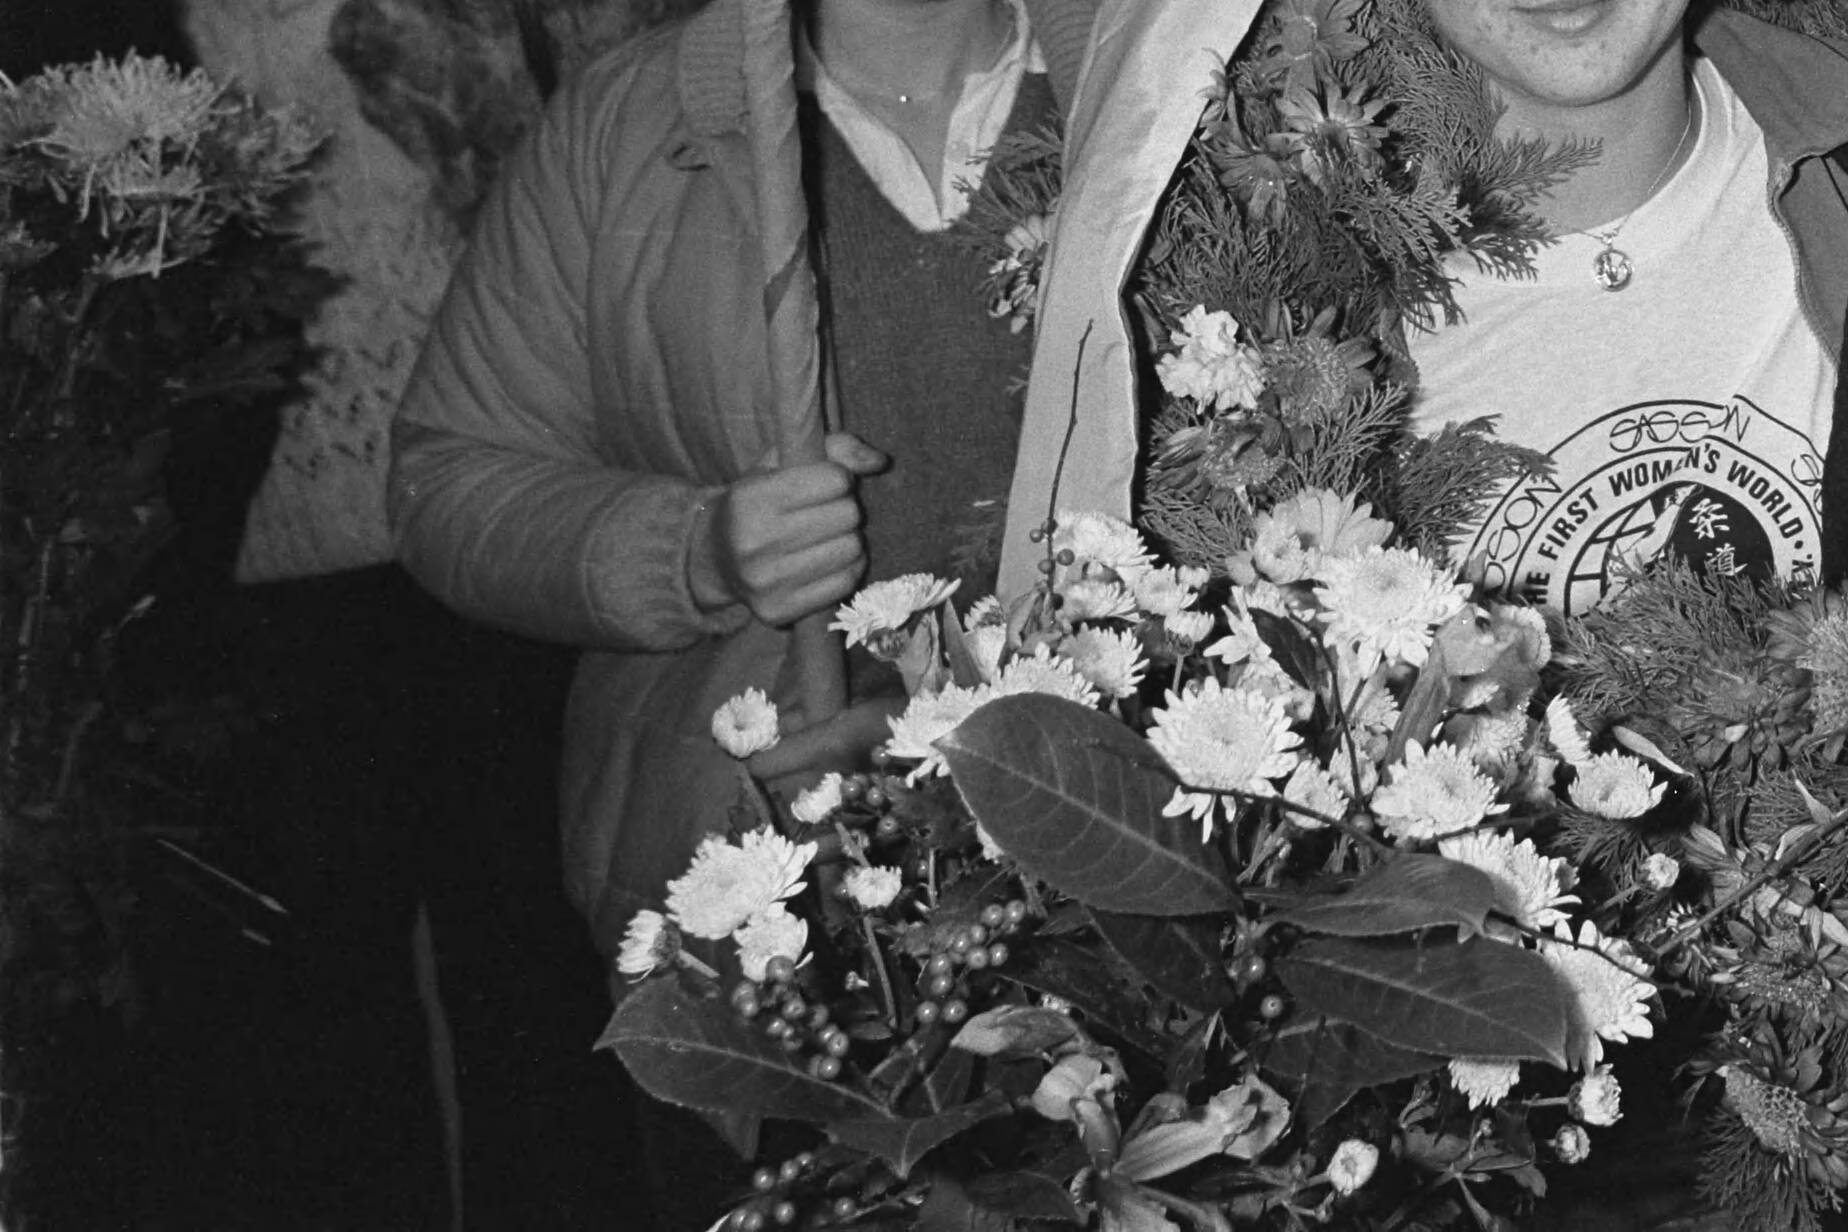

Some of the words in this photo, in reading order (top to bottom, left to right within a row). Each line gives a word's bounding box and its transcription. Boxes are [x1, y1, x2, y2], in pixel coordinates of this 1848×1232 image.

[1521, 571, 1551, 606] HE
[1537, 486, 1599, 561] FIRST
[1608, 443, 1721, 498] WOMN'S
[1726, 460, 1804, 539] WORLD
